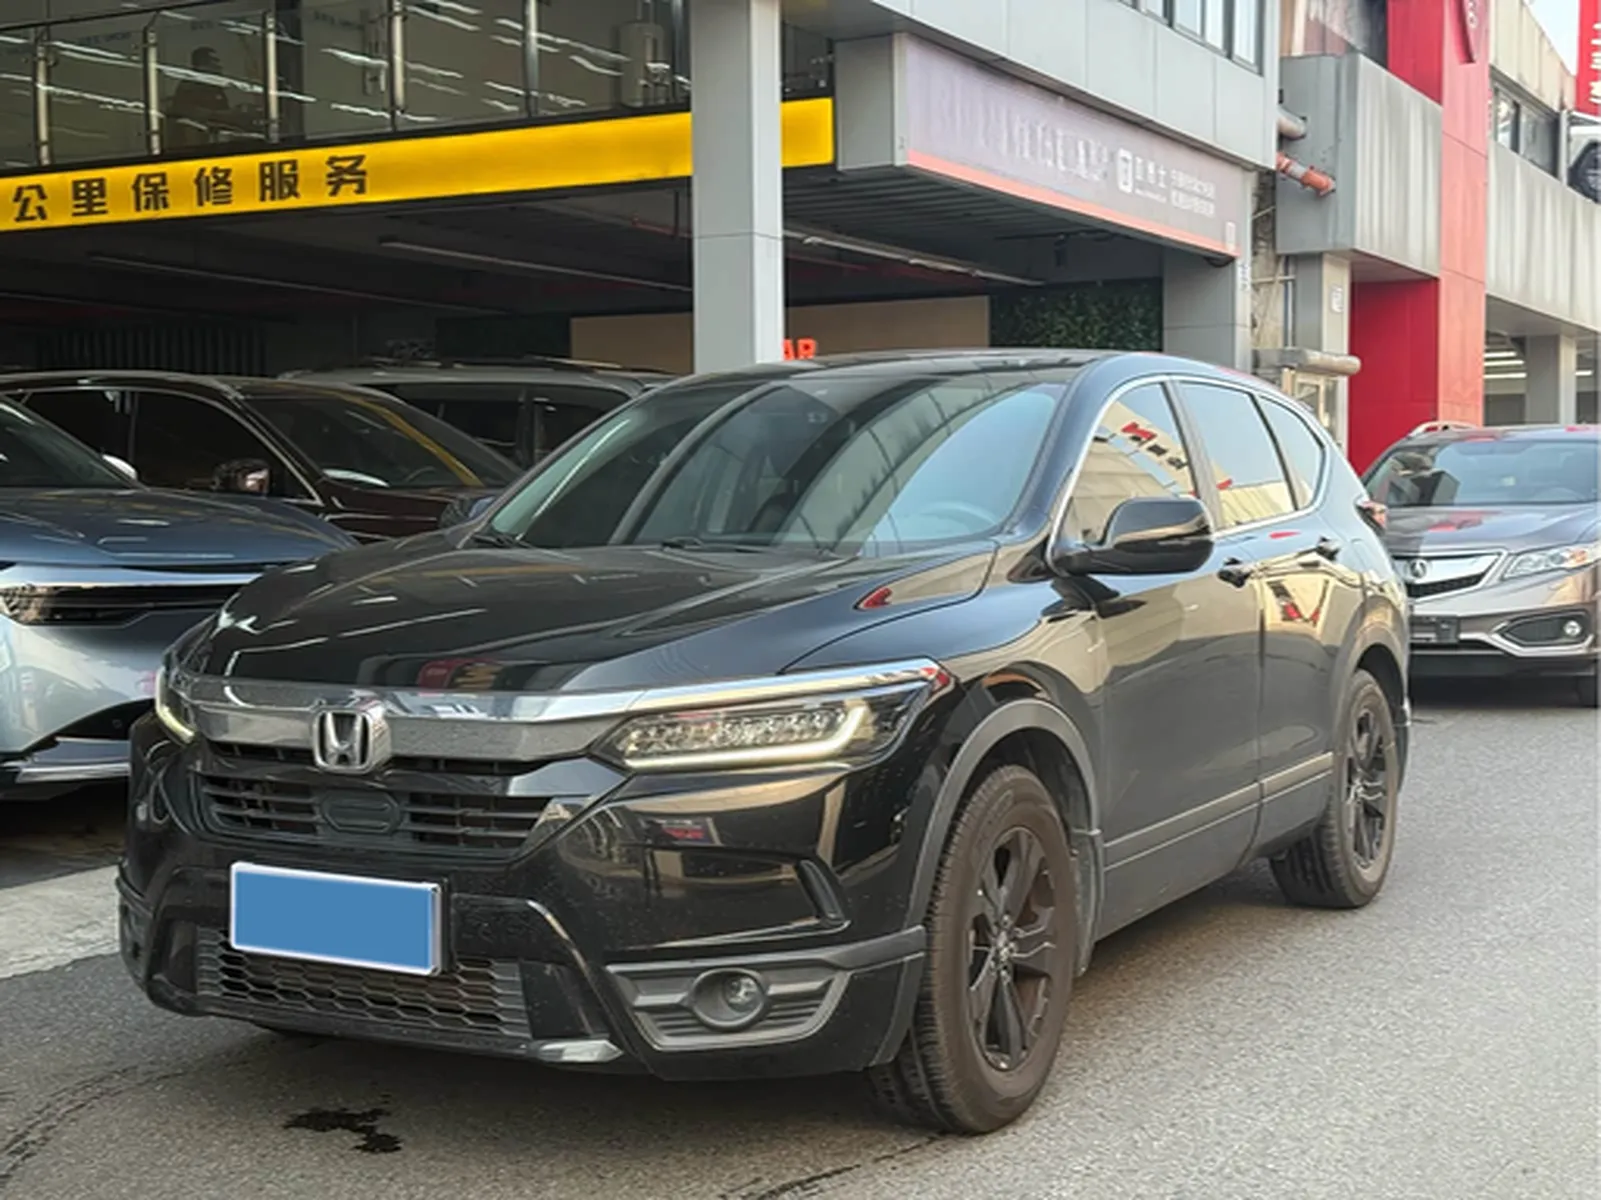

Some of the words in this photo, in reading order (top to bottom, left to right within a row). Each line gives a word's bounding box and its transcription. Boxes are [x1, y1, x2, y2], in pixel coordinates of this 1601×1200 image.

[13, 154, 367, 223] 公里保修服务
